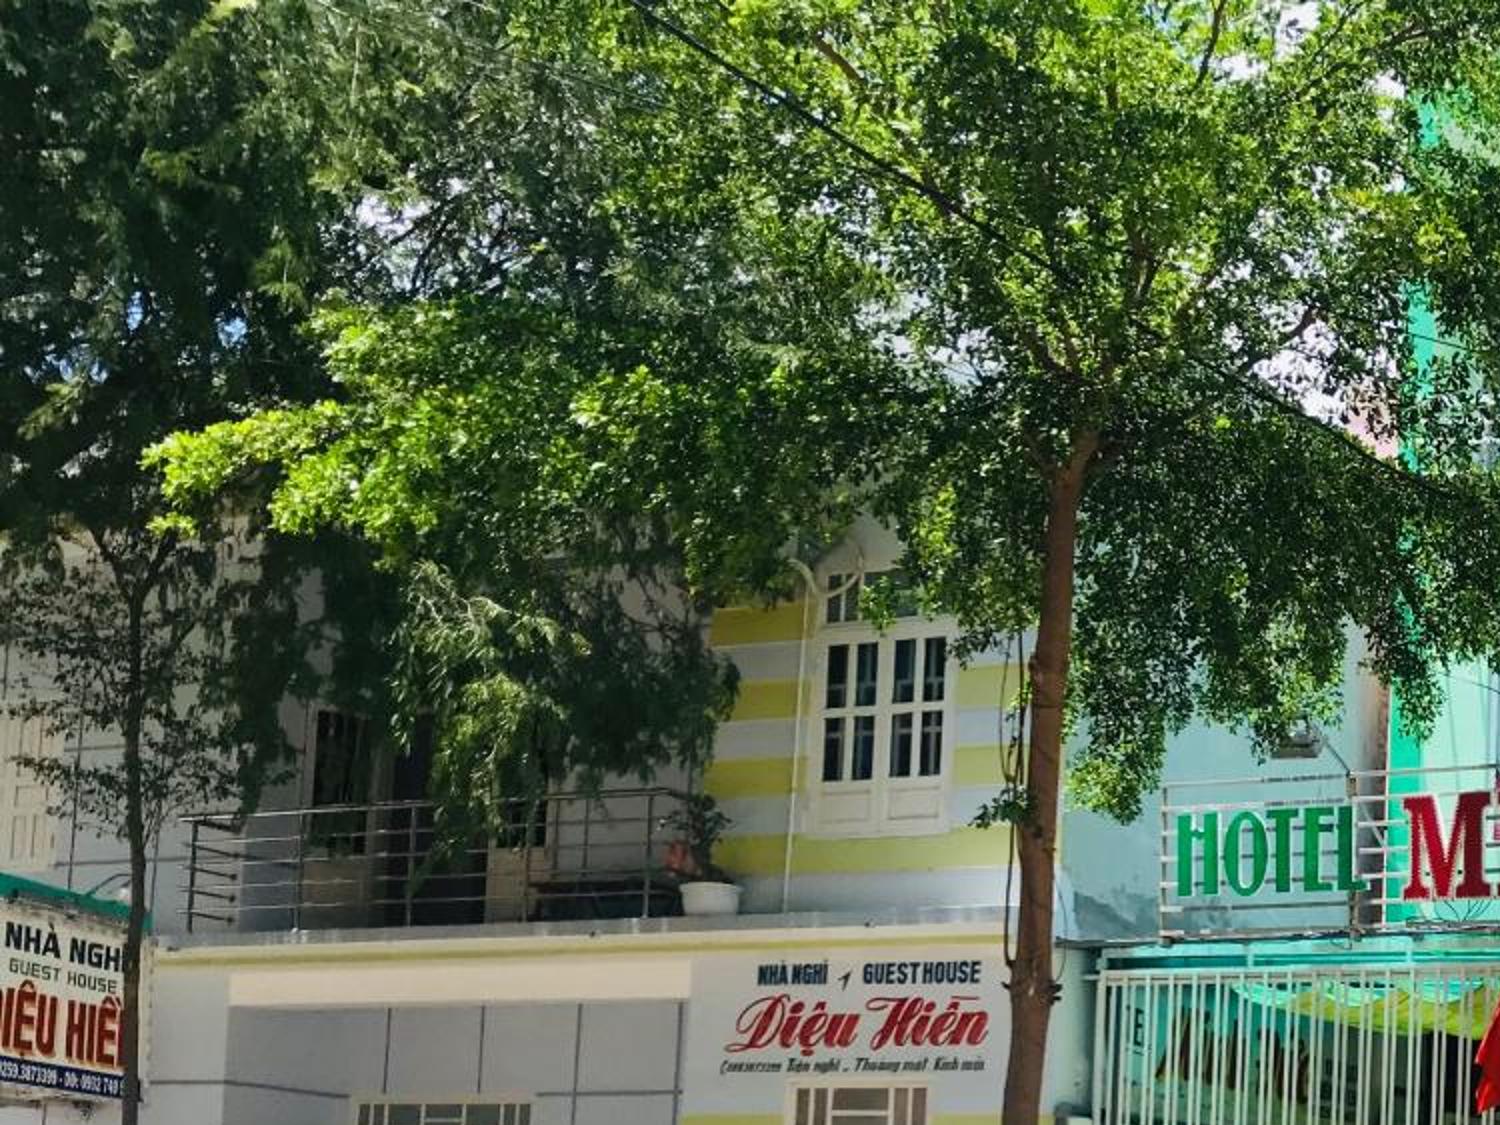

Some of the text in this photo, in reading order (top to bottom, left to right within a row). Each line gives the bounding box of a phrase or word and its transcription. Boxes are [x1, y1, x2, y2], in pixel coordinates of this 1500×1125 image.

[1177, 804, 1369, 897] HOTEL
[5, 920, 61, 959] NHÀ
[9, 957, 117, 994] GUEST HOUSE
[863, 961, 920, 985] GUEST
[922, 960, 982, 984] HOUSE
[0, 979, 58, 1058] IỆU
[725, 993, 989, 1057] Diệu Hiền
